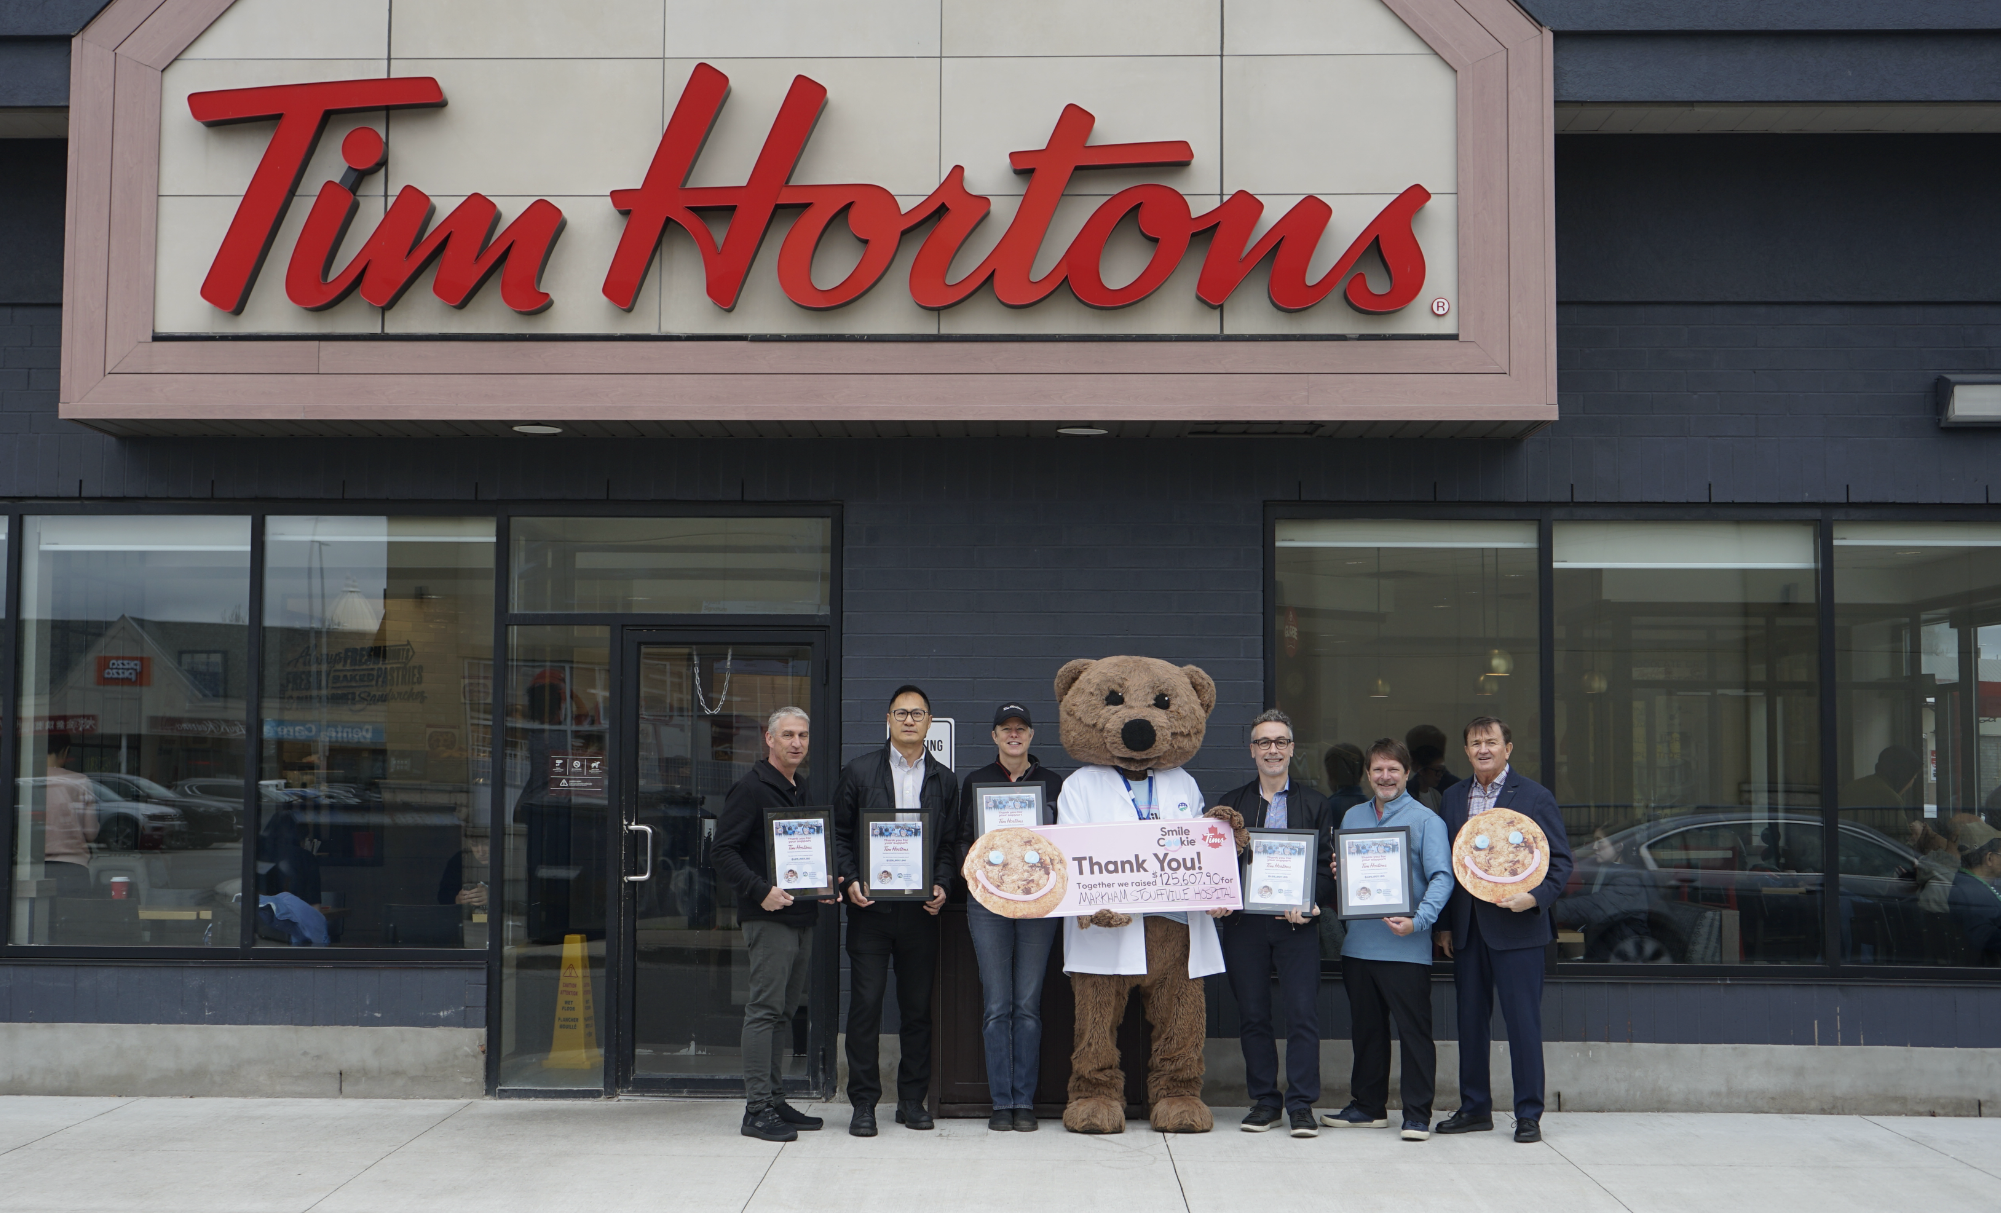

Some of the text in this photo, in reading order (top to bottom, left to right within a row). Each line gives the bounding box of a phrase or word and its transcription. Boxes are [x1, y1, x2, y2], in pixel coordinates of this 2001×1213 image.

[187, 77, 568, 315] Tim
[602, 62, 1431, 313] Hortons
[332, 672, 374, 683] BAKED
[375, 665, 423, 687] PASTRIES
[1160, 826, 1190, 836] Smile
[1157, 837, 1196, 847] Cookie
[1204, 833, 1226, 844] Tims
[1072, 852, 1202, 875] Thank You!
[1076, 881, 1116, 891] Together
[1131, 880, 1157, 888] raised
[1079, 889, 1128, 905] MARKHAM
[1194, 887, 1236, 900] HOSPITAL
